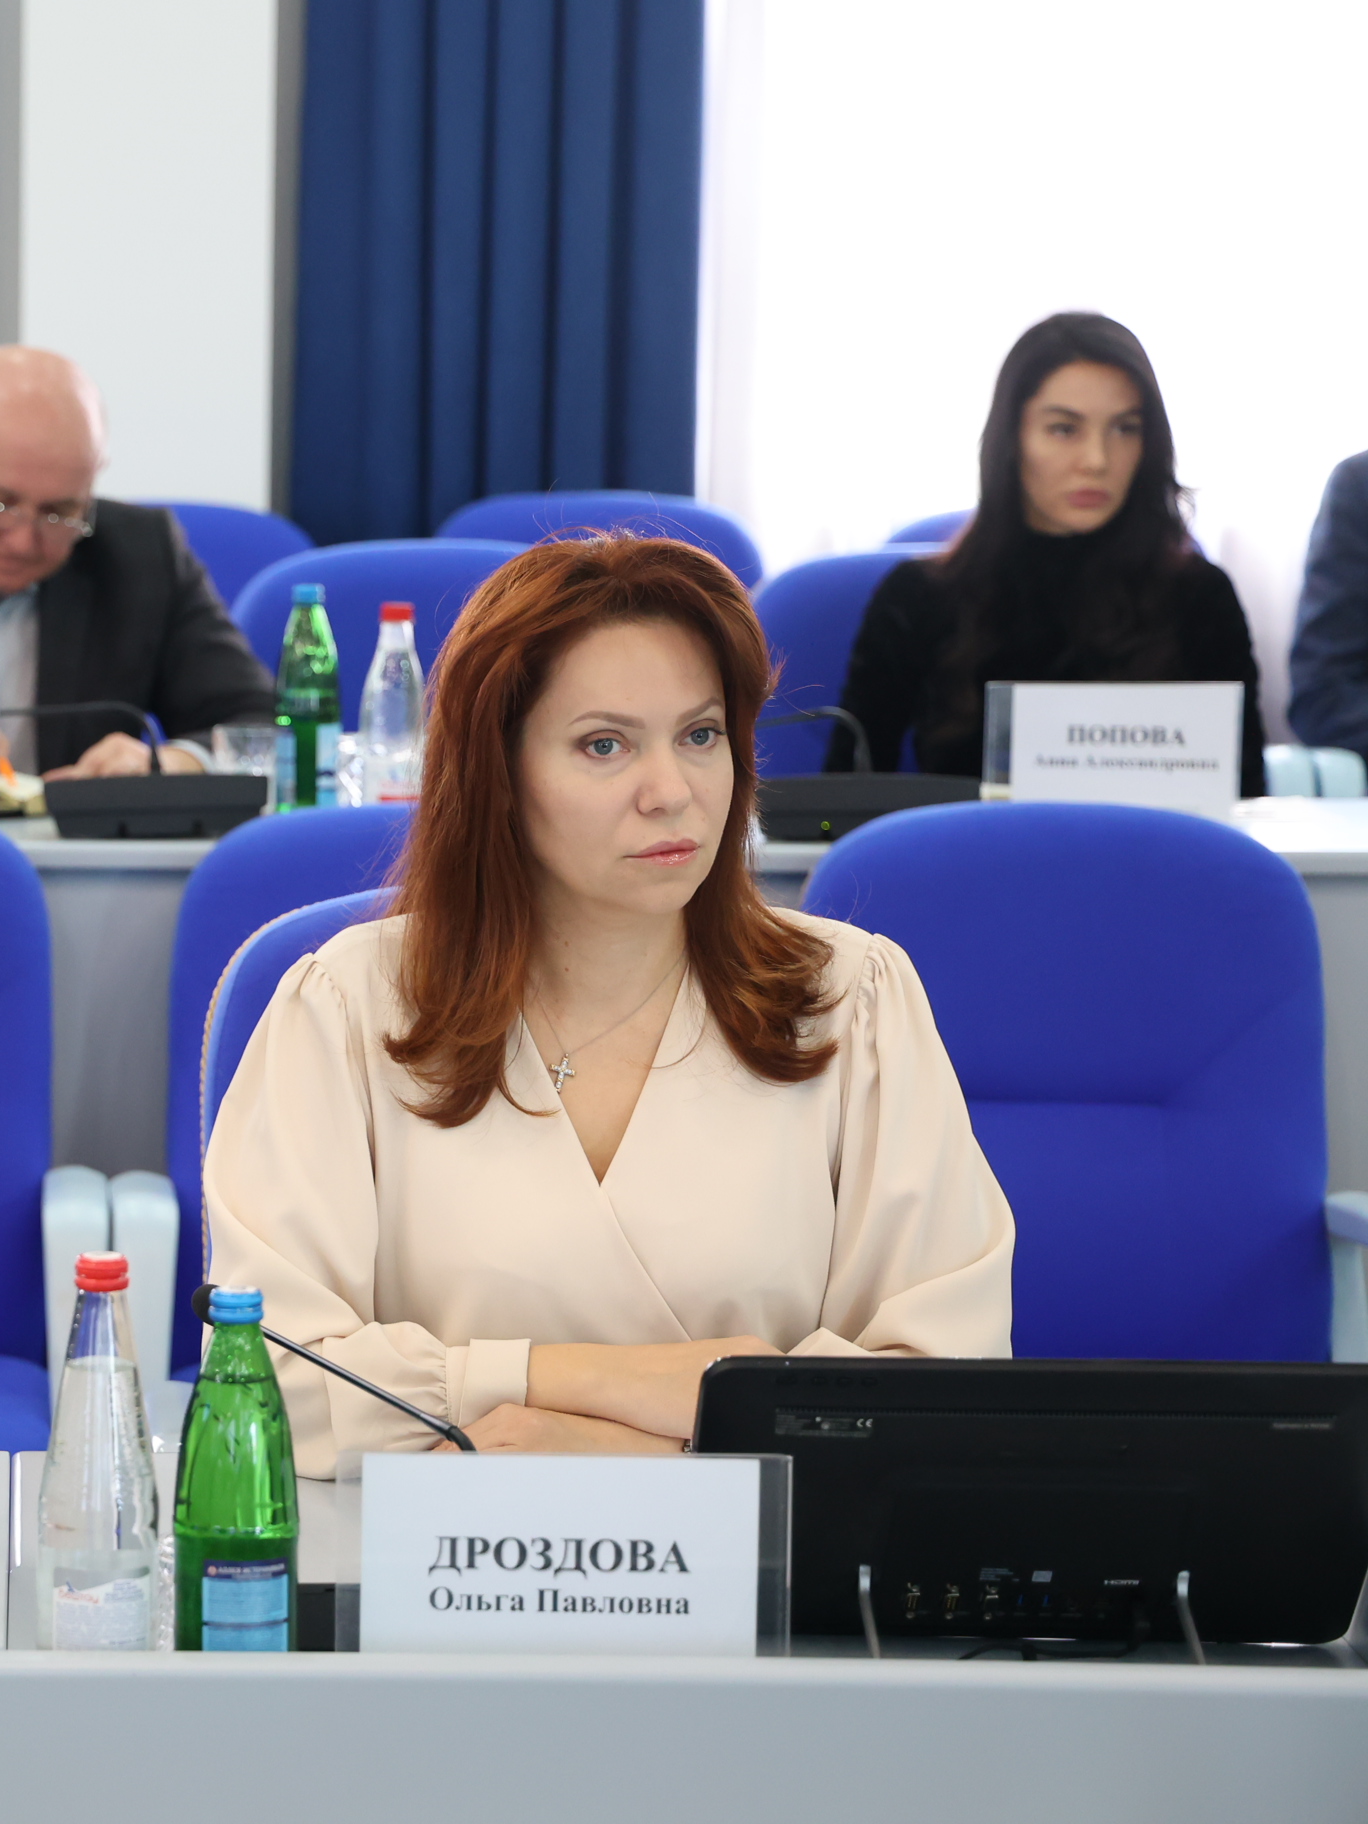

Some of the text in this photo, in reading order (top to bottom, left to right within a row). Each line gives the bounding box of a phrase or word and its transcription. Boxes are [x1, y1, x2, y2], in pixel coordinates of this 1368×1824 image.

[1066, 724, 1186, 747] ПОПОВА
[429, 1537, 690, 1578] ДРОЗДОВА
[429, 1587, 690, 1615] Ольга Павловна
